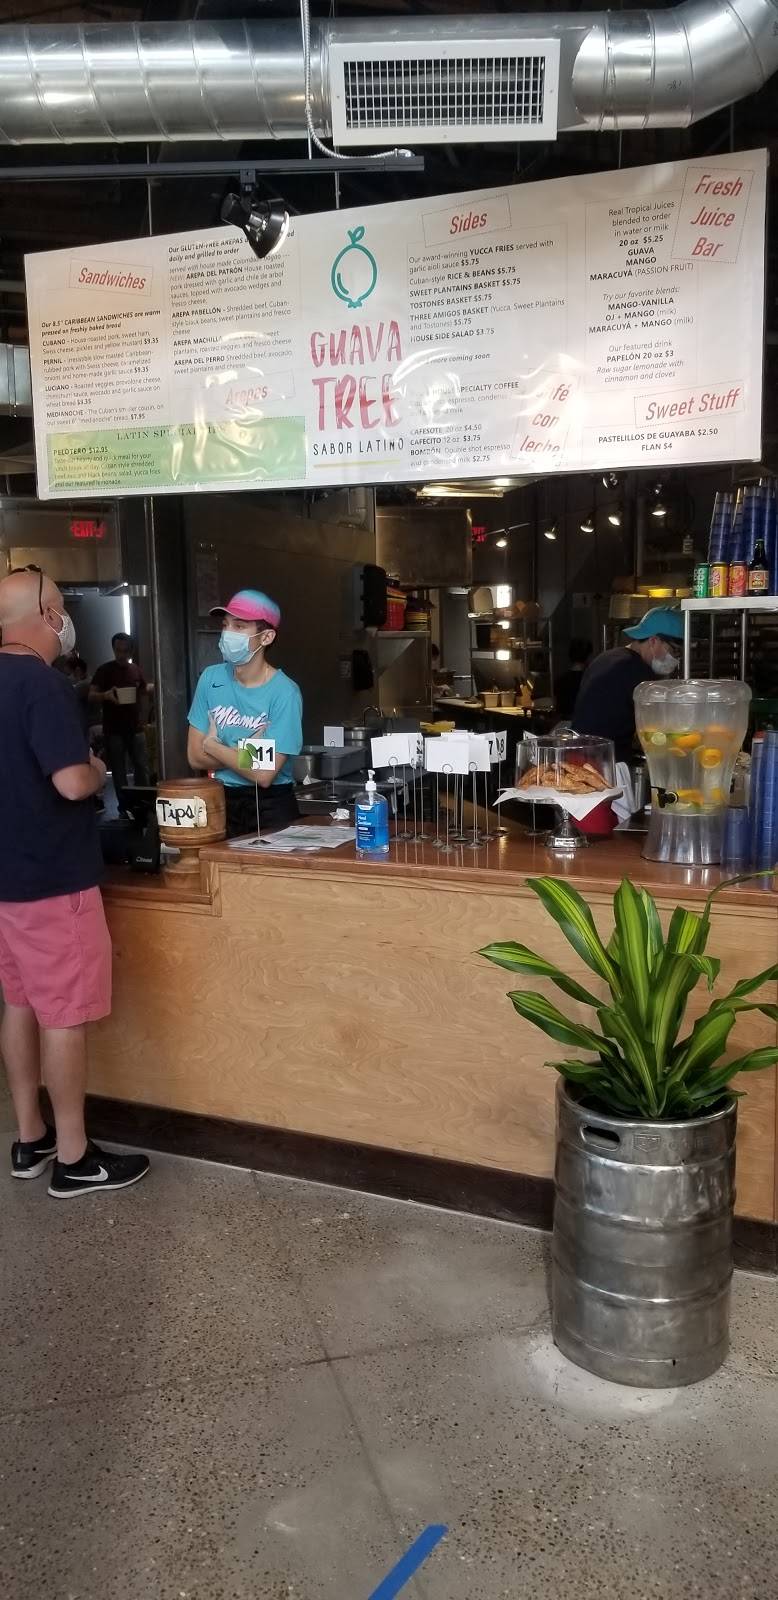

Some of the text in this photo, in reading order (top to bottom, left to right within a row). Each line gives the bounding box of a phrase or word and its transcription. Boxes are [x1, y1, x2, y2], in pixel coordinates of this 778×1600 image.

[695, 175, 743, 196] Fresh
[625, 206, 651, 215] Tropical
[653, 201, 675, 210] Juices
[612, 215, 640, 226] blended
[652, 212, 671, 221] order
[691, 206, 735, 226] Juice
[450, 212, 488, 235] Sides
[615, 229, 621, 237] in
[623, 227, 642, 235] water
[653, 223, 669, 231] milk
[619, 239, 629, 247] 20
[643, 235, 663, 244] $5.25
[692, 237, 723, 257] Bar
[197, 250, 215, 258] grilled
[422, 250, 468, 263] award-winning
[470, 247, 493, 256] YUCCA
[495, 244, 514, 252] FRIES
[516, 242, 537, 250] served
[627, 246, 654, 256] GUAVA
[461, 258, 480, 266] $5.75
[626, 257, 657, 267] MANGO
[219, 267, 243, 275] PATRÓN
[447, 272, 462, 280] RICE
[472, 269, 495, 277] BEANS
[497, 266, 516, 275] $5.75
[590, 263, 694, 281] MARACUYÁ (PASSION FRUIT)
[79, 267, 146, 290] Sandwiches
[410, 278, 521, 297] SWEET PLANTAINS BASKET $5.75
[627, 290, 654, 299] favorite
[410, 293, 492, 309] TOSTONES BASKET $5.75
[608, 297, 674, 310] MANGO-VANILLA
[192, 306, 221, 315] PABELLÓN
[410, 313, 431, 322] THREE
[433, 311, 461, 319] AMIGOS
[463, 307, 488, 316] BASKET
[625, 310, 655, 319] MANGO
[65, 316, 95, 325] CARIBBEAN
[97, 312, 133, 321] SANDWICHES
[454, 318, 472, 326] $5.75
[589, 321, 632, 333] MARACUYÁ
[642, 319, 672, 328] MANGO
[411, 334, 433, 343] HOUSE
[435, 332, 449, 340] SIDE
[452, 330, 474, 338] SALAD
[310, 320, 403, 368] GUAVA
[623, 341, 652, 350] featured
[607, 352, 640, 363] PAPELÓN
[494, 382, 519, 390] COFFEE
[226, 386, 268, 406] Arepas
[312, 374, 403, 431] TREE
[645, 388, 740, 421] Sweet Stuff
[117, 431, 149, 440] LATIN
[411, 438, 441, 446] CAFECITO
[599, 433, 645, 443] PASTELILLOS
[659, 430, 695, 439] GUAYABA
[698, 428, 718, 436] $2.50
[314, 438, 404, 456] SABOR LATINO
[642, 443, 661, 451] FLAN
[472, 455, 490, 463] $2.75
[210, 705, 268, 729] Miami
[256, 746, 273, 762] 11
[489, 741, 493, 755] 7
[157, 800, 194, 825] Tips
